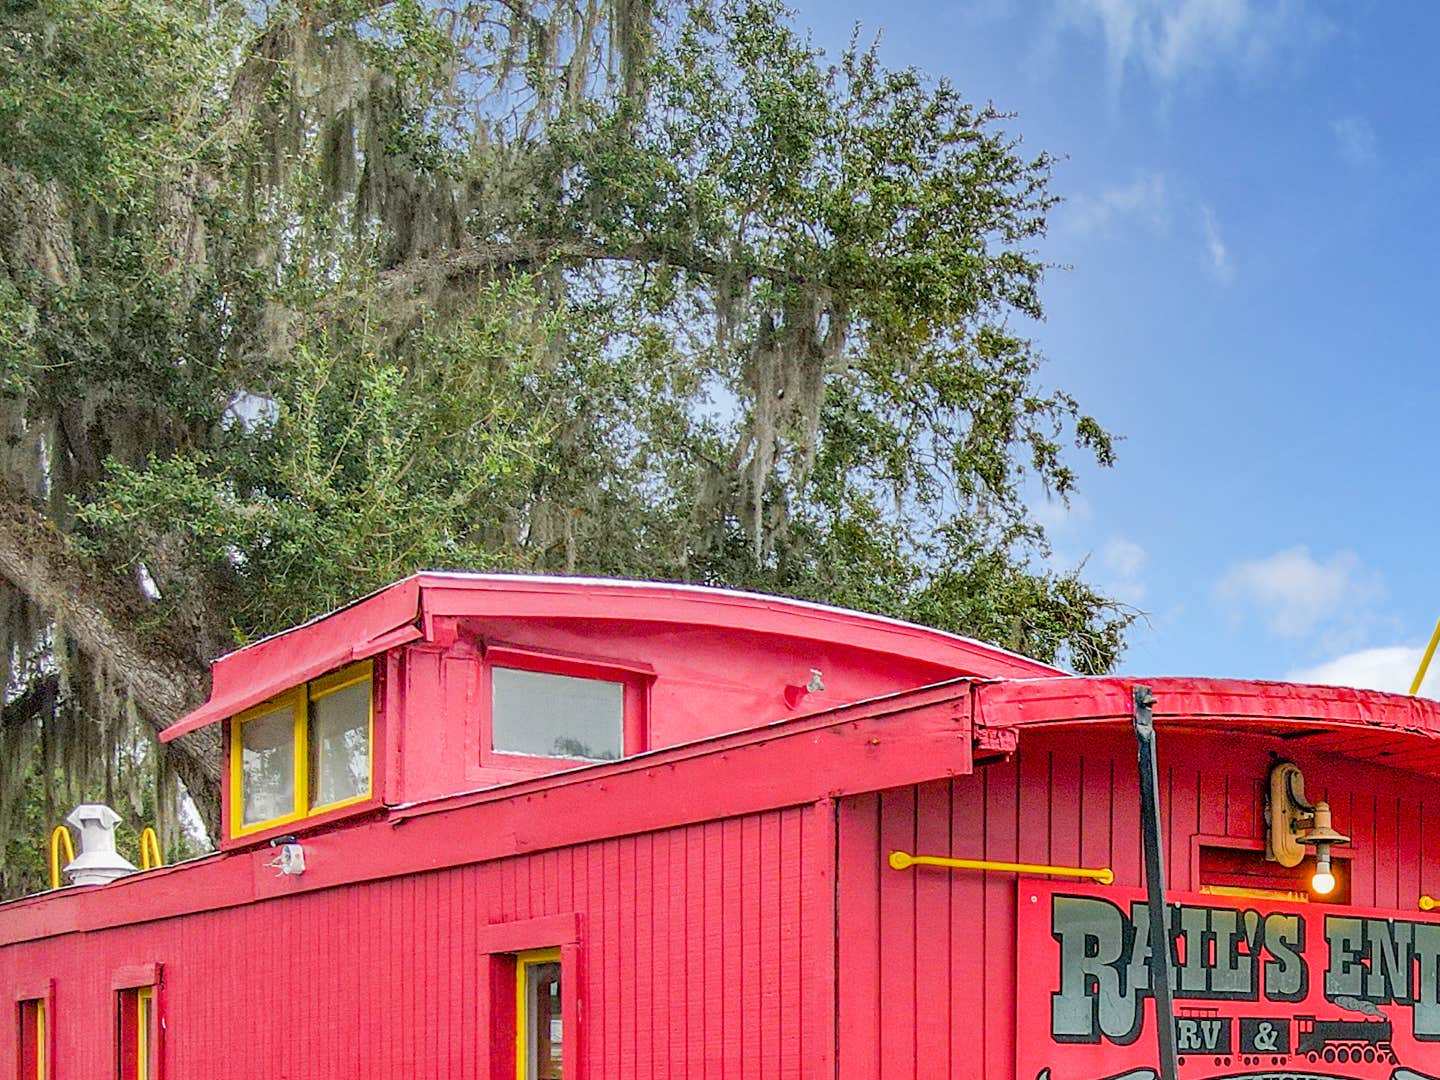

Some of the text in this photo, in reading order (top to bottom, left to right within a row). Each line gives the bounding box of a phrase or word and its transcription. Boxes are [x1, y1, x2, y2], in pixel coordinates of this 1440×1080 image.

[1051, 893, 1307, 1044] RAIL'S
[1178, 1018, 1279, 1051] RV &
